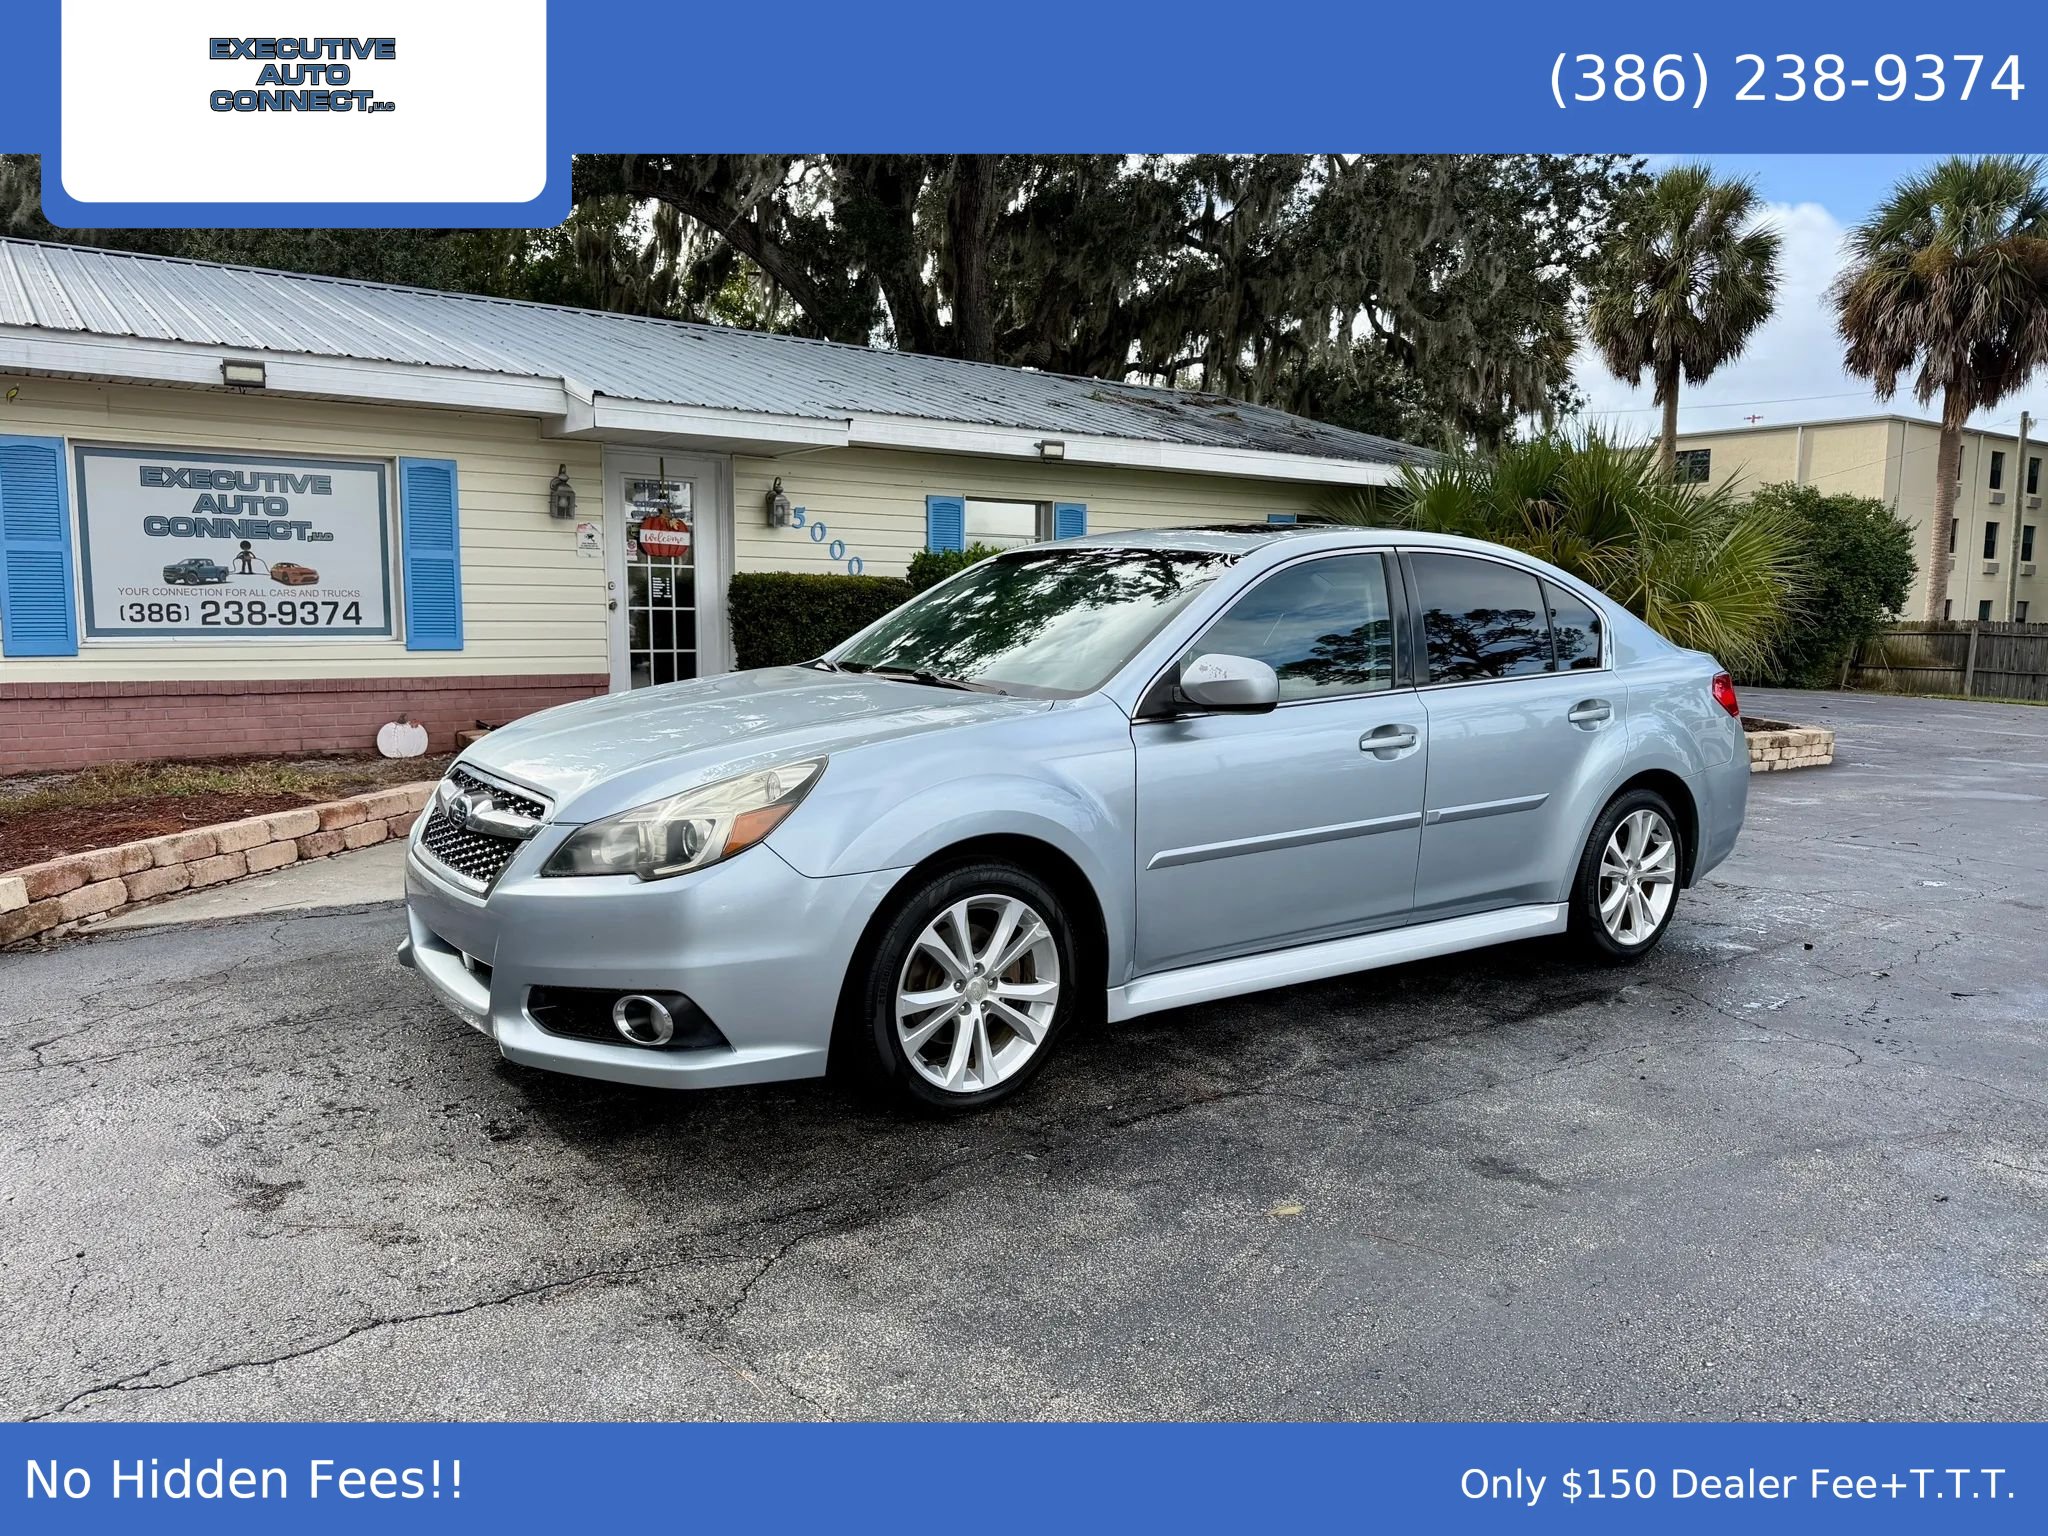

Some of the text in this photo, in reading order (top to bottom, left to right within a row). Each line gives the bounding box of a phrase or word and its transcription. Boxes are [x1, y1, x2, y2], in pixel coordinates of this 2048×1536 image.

[140, 466, 332, 495] EXECUTIVE
[192, 493, 288, 517] AUTO
[118, 587, 149, 596] YOUR
[152, 588, 223, 597] CONNECTION
[225, 588, 247, 597] FOR
[249, 589, 266, 597] ALL
[269, 589, 297, 597] CARS
[322, 590, 361, 598] TRUCKS
[120, 600, 362, 626] (386) 238-9374
